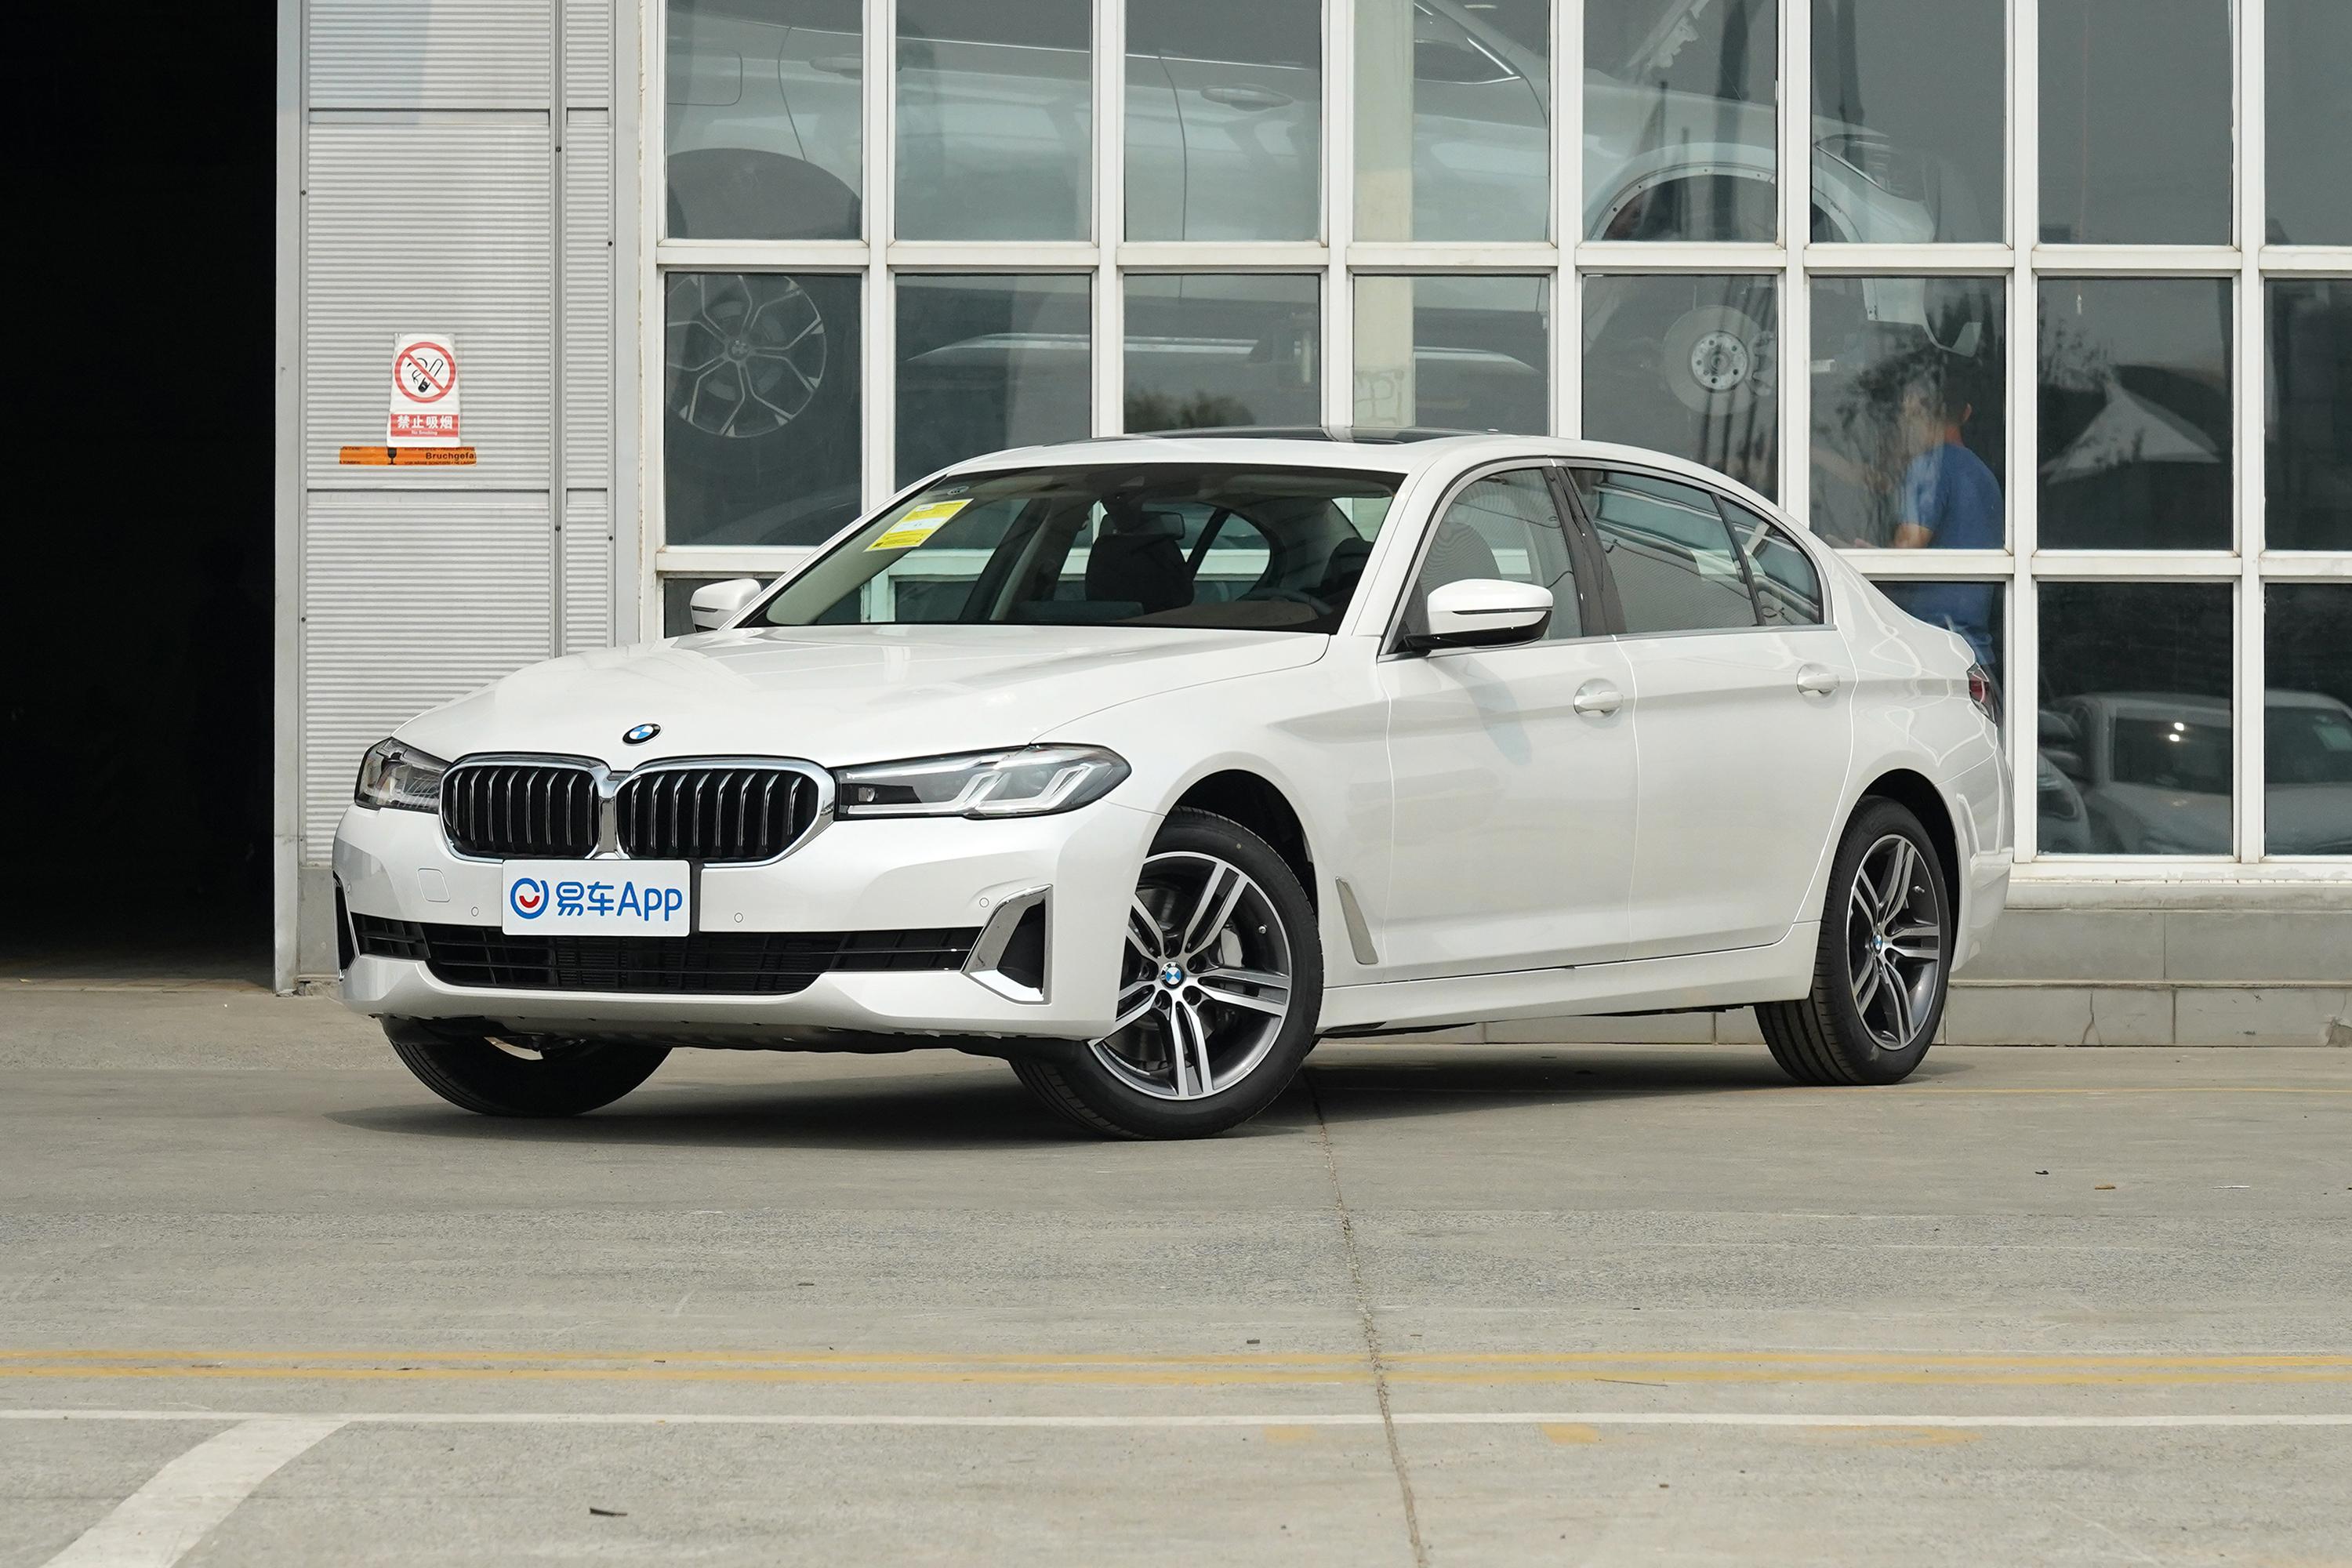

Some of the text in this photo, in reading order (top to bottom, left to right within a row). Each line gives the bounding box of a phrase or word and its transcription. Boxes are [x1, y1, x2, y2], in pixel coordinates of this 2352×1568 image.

[397, 415, 452, 429] 禁止吸烟
[426, 452, 477, 460] Bruchgefa
[556, 881, 683, 921] 易车App
